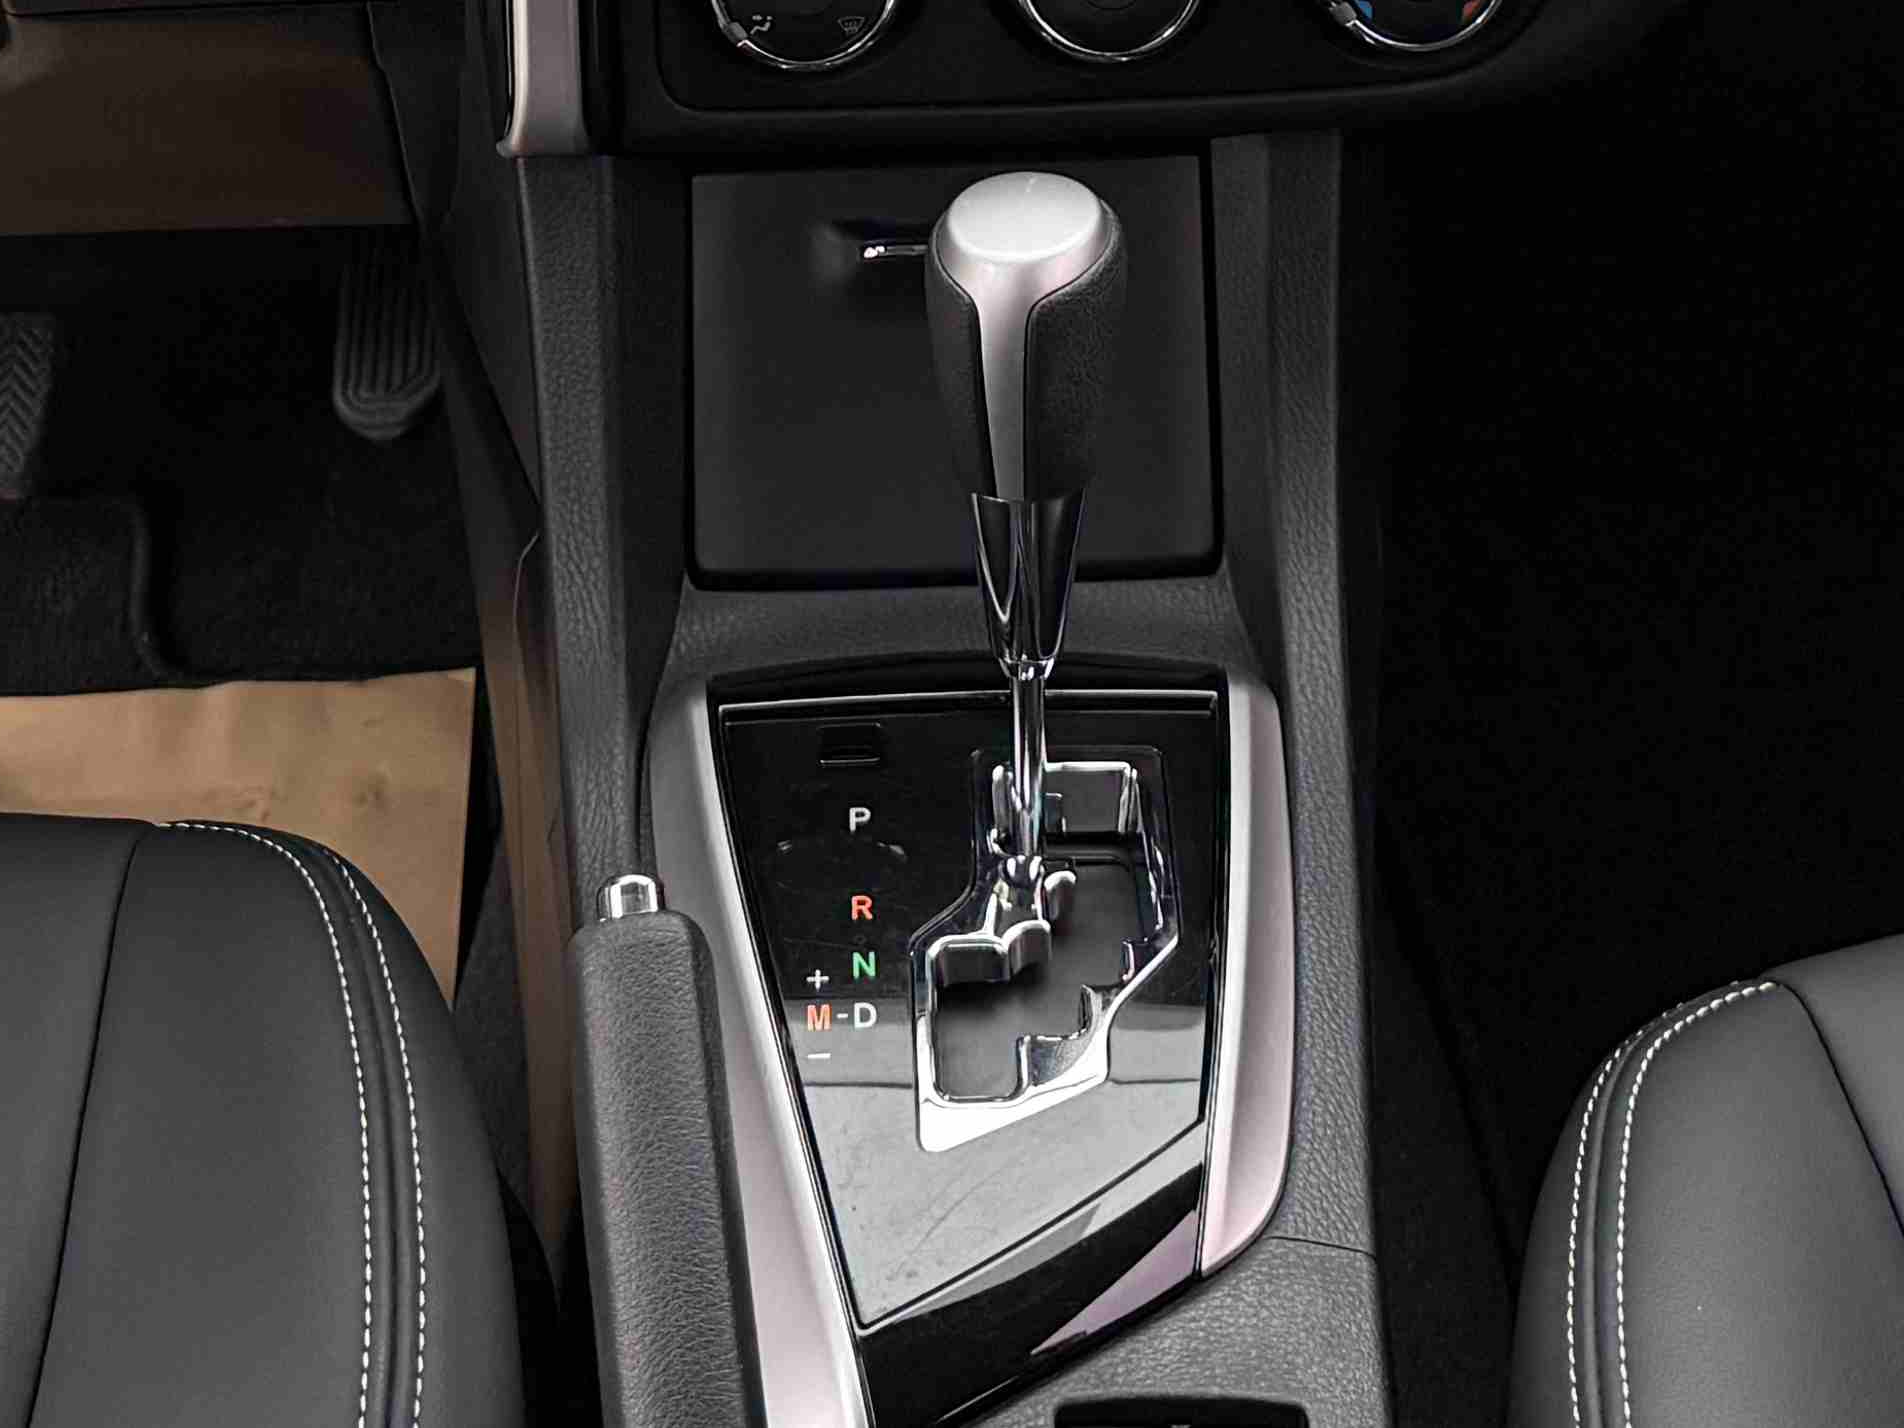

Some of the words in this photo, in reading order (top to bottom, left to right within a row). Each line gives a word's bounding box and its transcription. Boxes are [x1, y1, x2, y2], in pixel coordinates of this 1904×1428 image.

[848, 806, 872, 832] P
[851, 894, 874, 921] R
[852, 952, 877, 979] N
